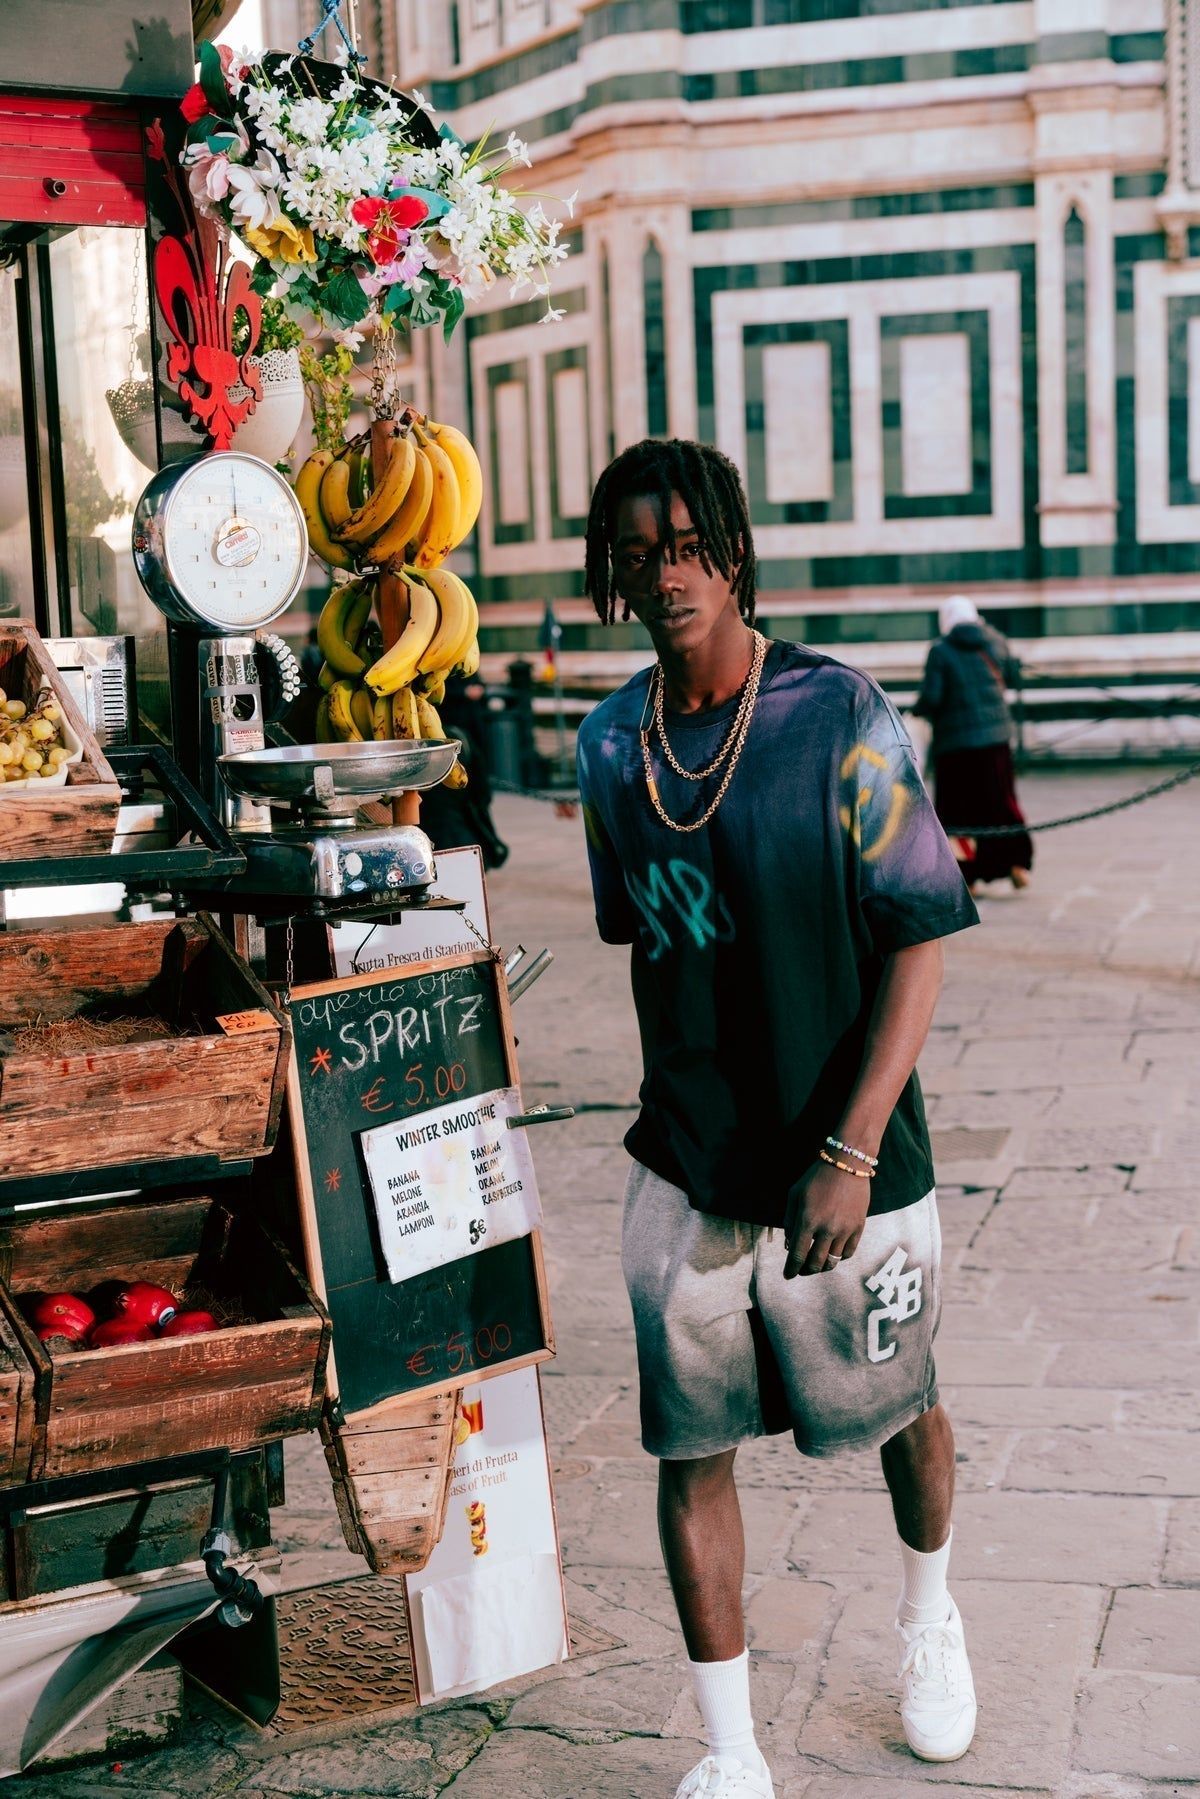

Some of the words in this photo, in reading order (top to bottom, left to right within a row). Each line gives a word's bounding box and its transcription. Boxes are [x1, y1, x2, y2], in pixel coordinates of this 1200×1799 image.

[387, 950, 421, 967] Fresca
[422, 946, 434, 960] di
[435, 940, 479, 958] Stagione
[339, 993, 483, 1071] SPRITZ
[396, 1123, 441, 1152] WINTER
[442, 1104, 496, 1136] SMOOTHIE
[470, 1141, 501, 1161] BANANA
[387, 1170, 420, 1190] BANANA
[391, 1185, 422, 1206] MELONE
[397, 1200, 430, 1221] ARANCIA
[399, 1215, 435, 1237] LAMPONI
[453, 1463, 470, 1479] ieri
[472, 1459, 483, 1473] di
[485, 1451, 518, 1468] Frutta
[449, 1483, 467, 1497] ass
[468, 1477, 479, 1492] of
[481, 1470, 507, 1487] Fruit
